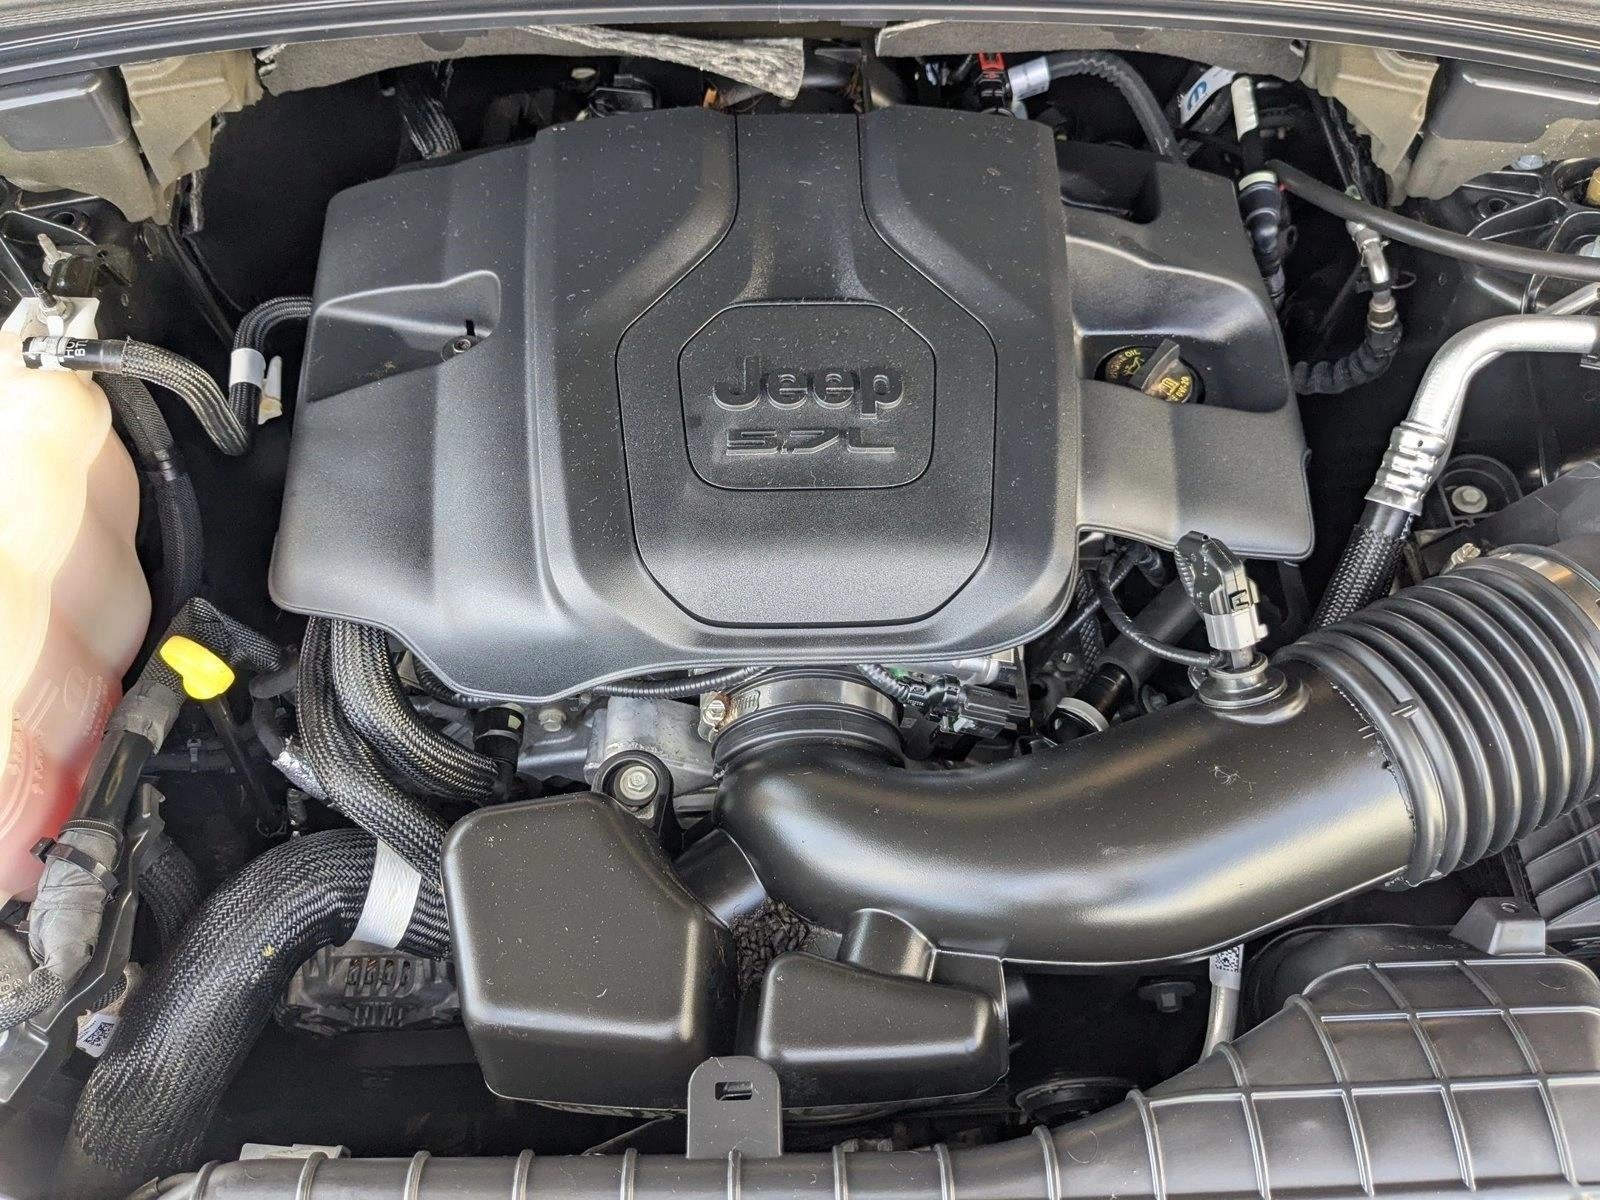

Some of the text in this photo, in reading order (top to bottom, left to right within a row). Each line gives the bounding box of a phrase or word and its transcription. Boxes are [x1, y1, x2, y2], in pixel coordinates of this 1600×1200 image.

[1125, 349, 1141, 358] OIL
[713, 356, 904, 419] Jeep
[726, 428, 896, 455] 5.7L
